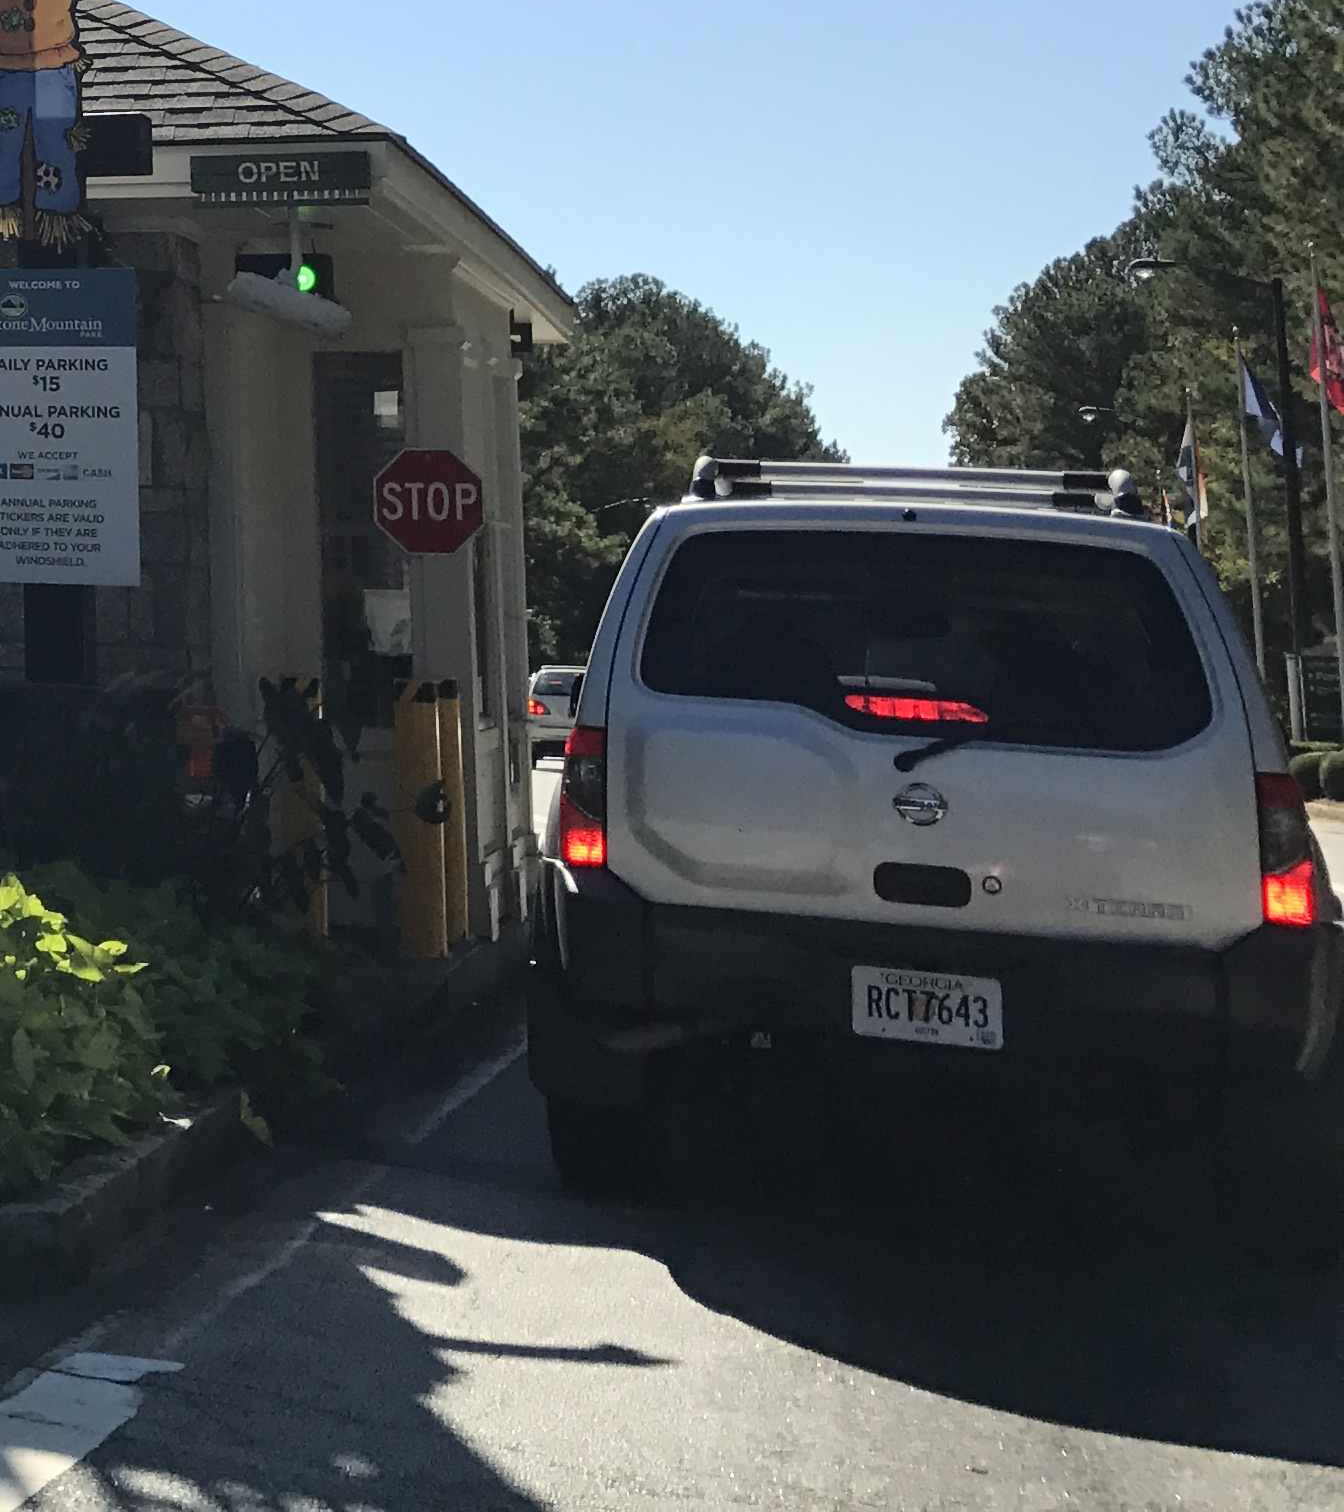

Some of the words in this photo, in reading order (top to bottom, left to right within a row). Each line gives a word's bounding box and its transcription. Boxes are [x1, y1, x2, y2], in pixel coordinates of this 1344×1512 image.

[238, 160, 320, 184] OPEN
[9, 280, 61, 289] WELCOME
[65, 280, 80, 289] TO
[36, 358, 109, 371] PARKING
[32, 375, 61, 391] $15
[47, 405, 121, 418] PARKING
[29, 421, 65, 438] $40
[17, 451, 34, 460] WE
[38, 451, 79, 460] ACCEPT
[1, 498, 45, 507] ANNUAL
[48, 499, 97, 508] PARKING
[382, 481, 478, 521] STOP
[47, 513, 70, 523] ARE
[72, 513, 105, 524] VALID
[0, 527, 29, 536] ONLY
[31, 527, 41, 536] IF
[44, 528, 73, 537] THEY
[75, 528, 97, 537] ARE
[53, 542, 67, 552] TO
[69, 543, 101, 553] YOUR
